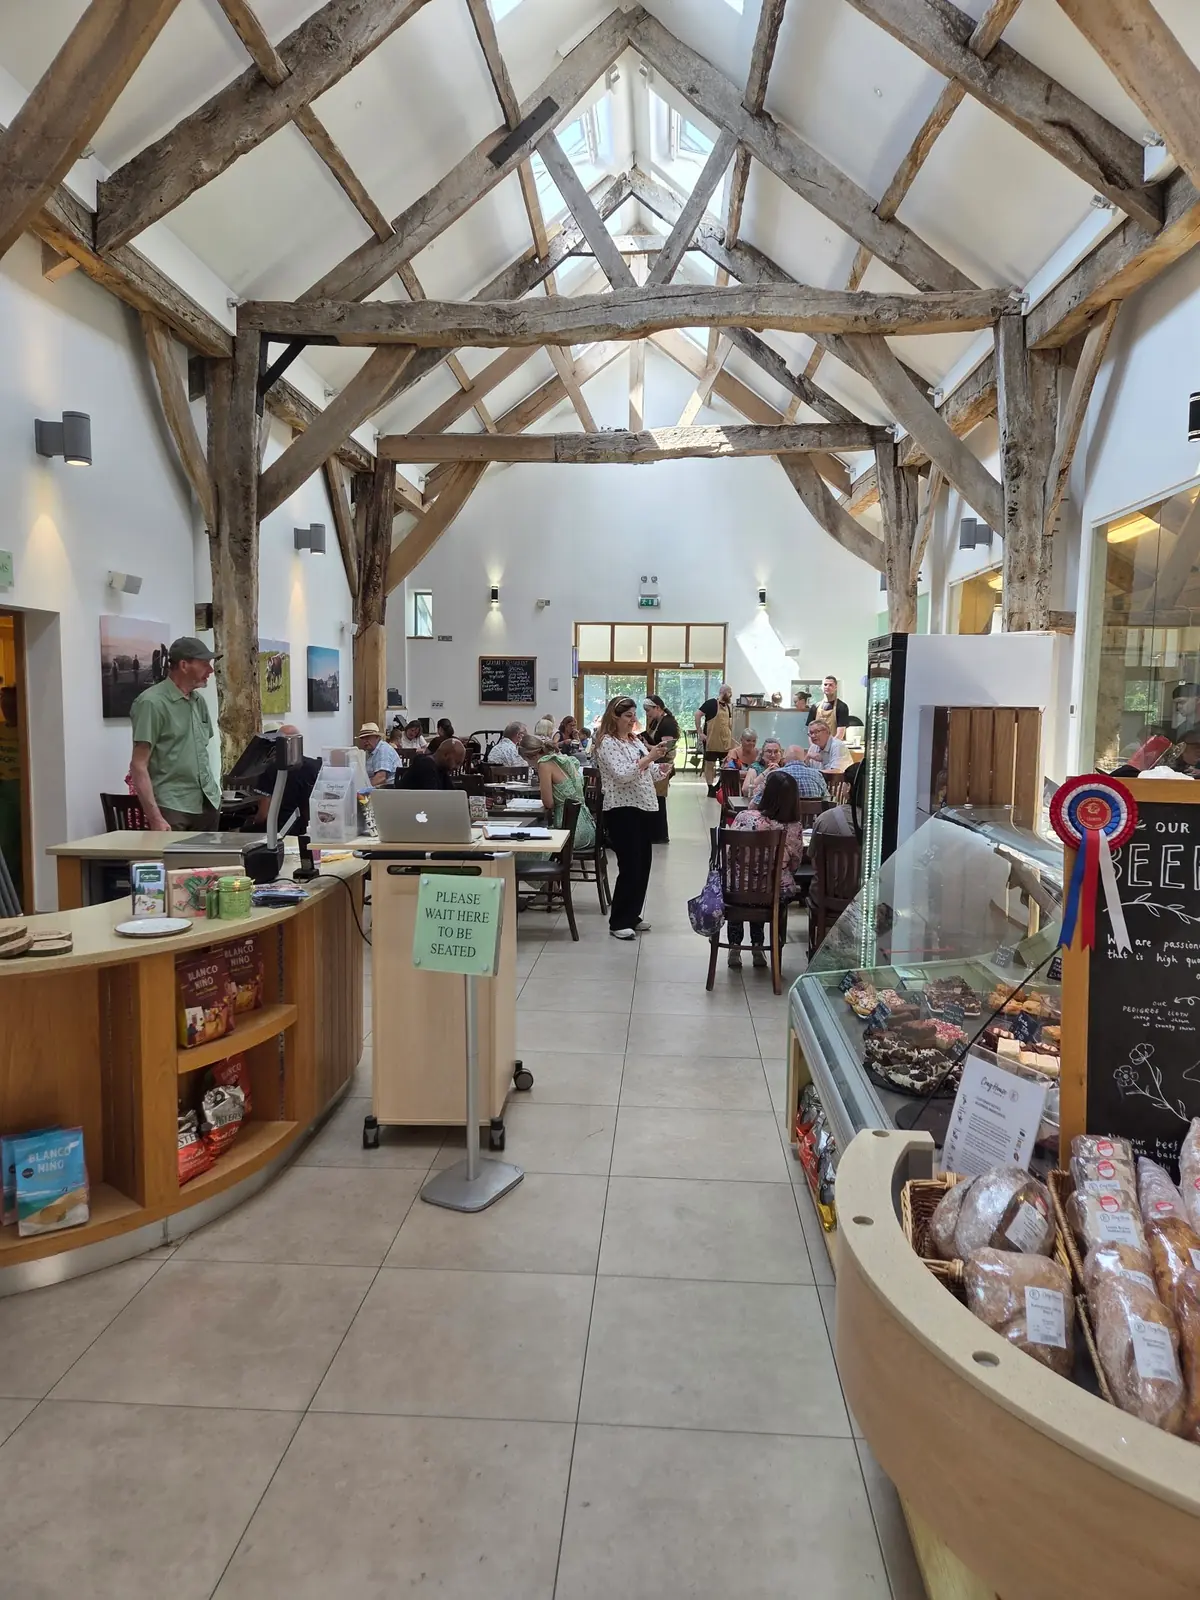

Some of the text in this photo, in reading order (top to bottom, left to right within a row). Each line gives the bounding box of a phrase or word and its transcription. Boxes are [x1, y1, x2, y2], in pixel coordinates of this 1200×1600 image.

[1155, 821, 1190, 834] OUR
[435, 891, 481, 905] PLEASE
[425, 907, 490, 923] WAIT HERE
[438, 926, 473, 940] TO BE
[430, 943, 476, 958] SEATED
[1134, 938, 1152, 948] are
[224, 944, 254, 959] BLANCO
[1135, 952, 1144, 961] is
[1156, 952, 1178, 968] high
[187, 964, 219, 981] BLANCO
[1155, 1137, 1179, 1152] beef
[28, 1146, 72, 1164] BLANCO
